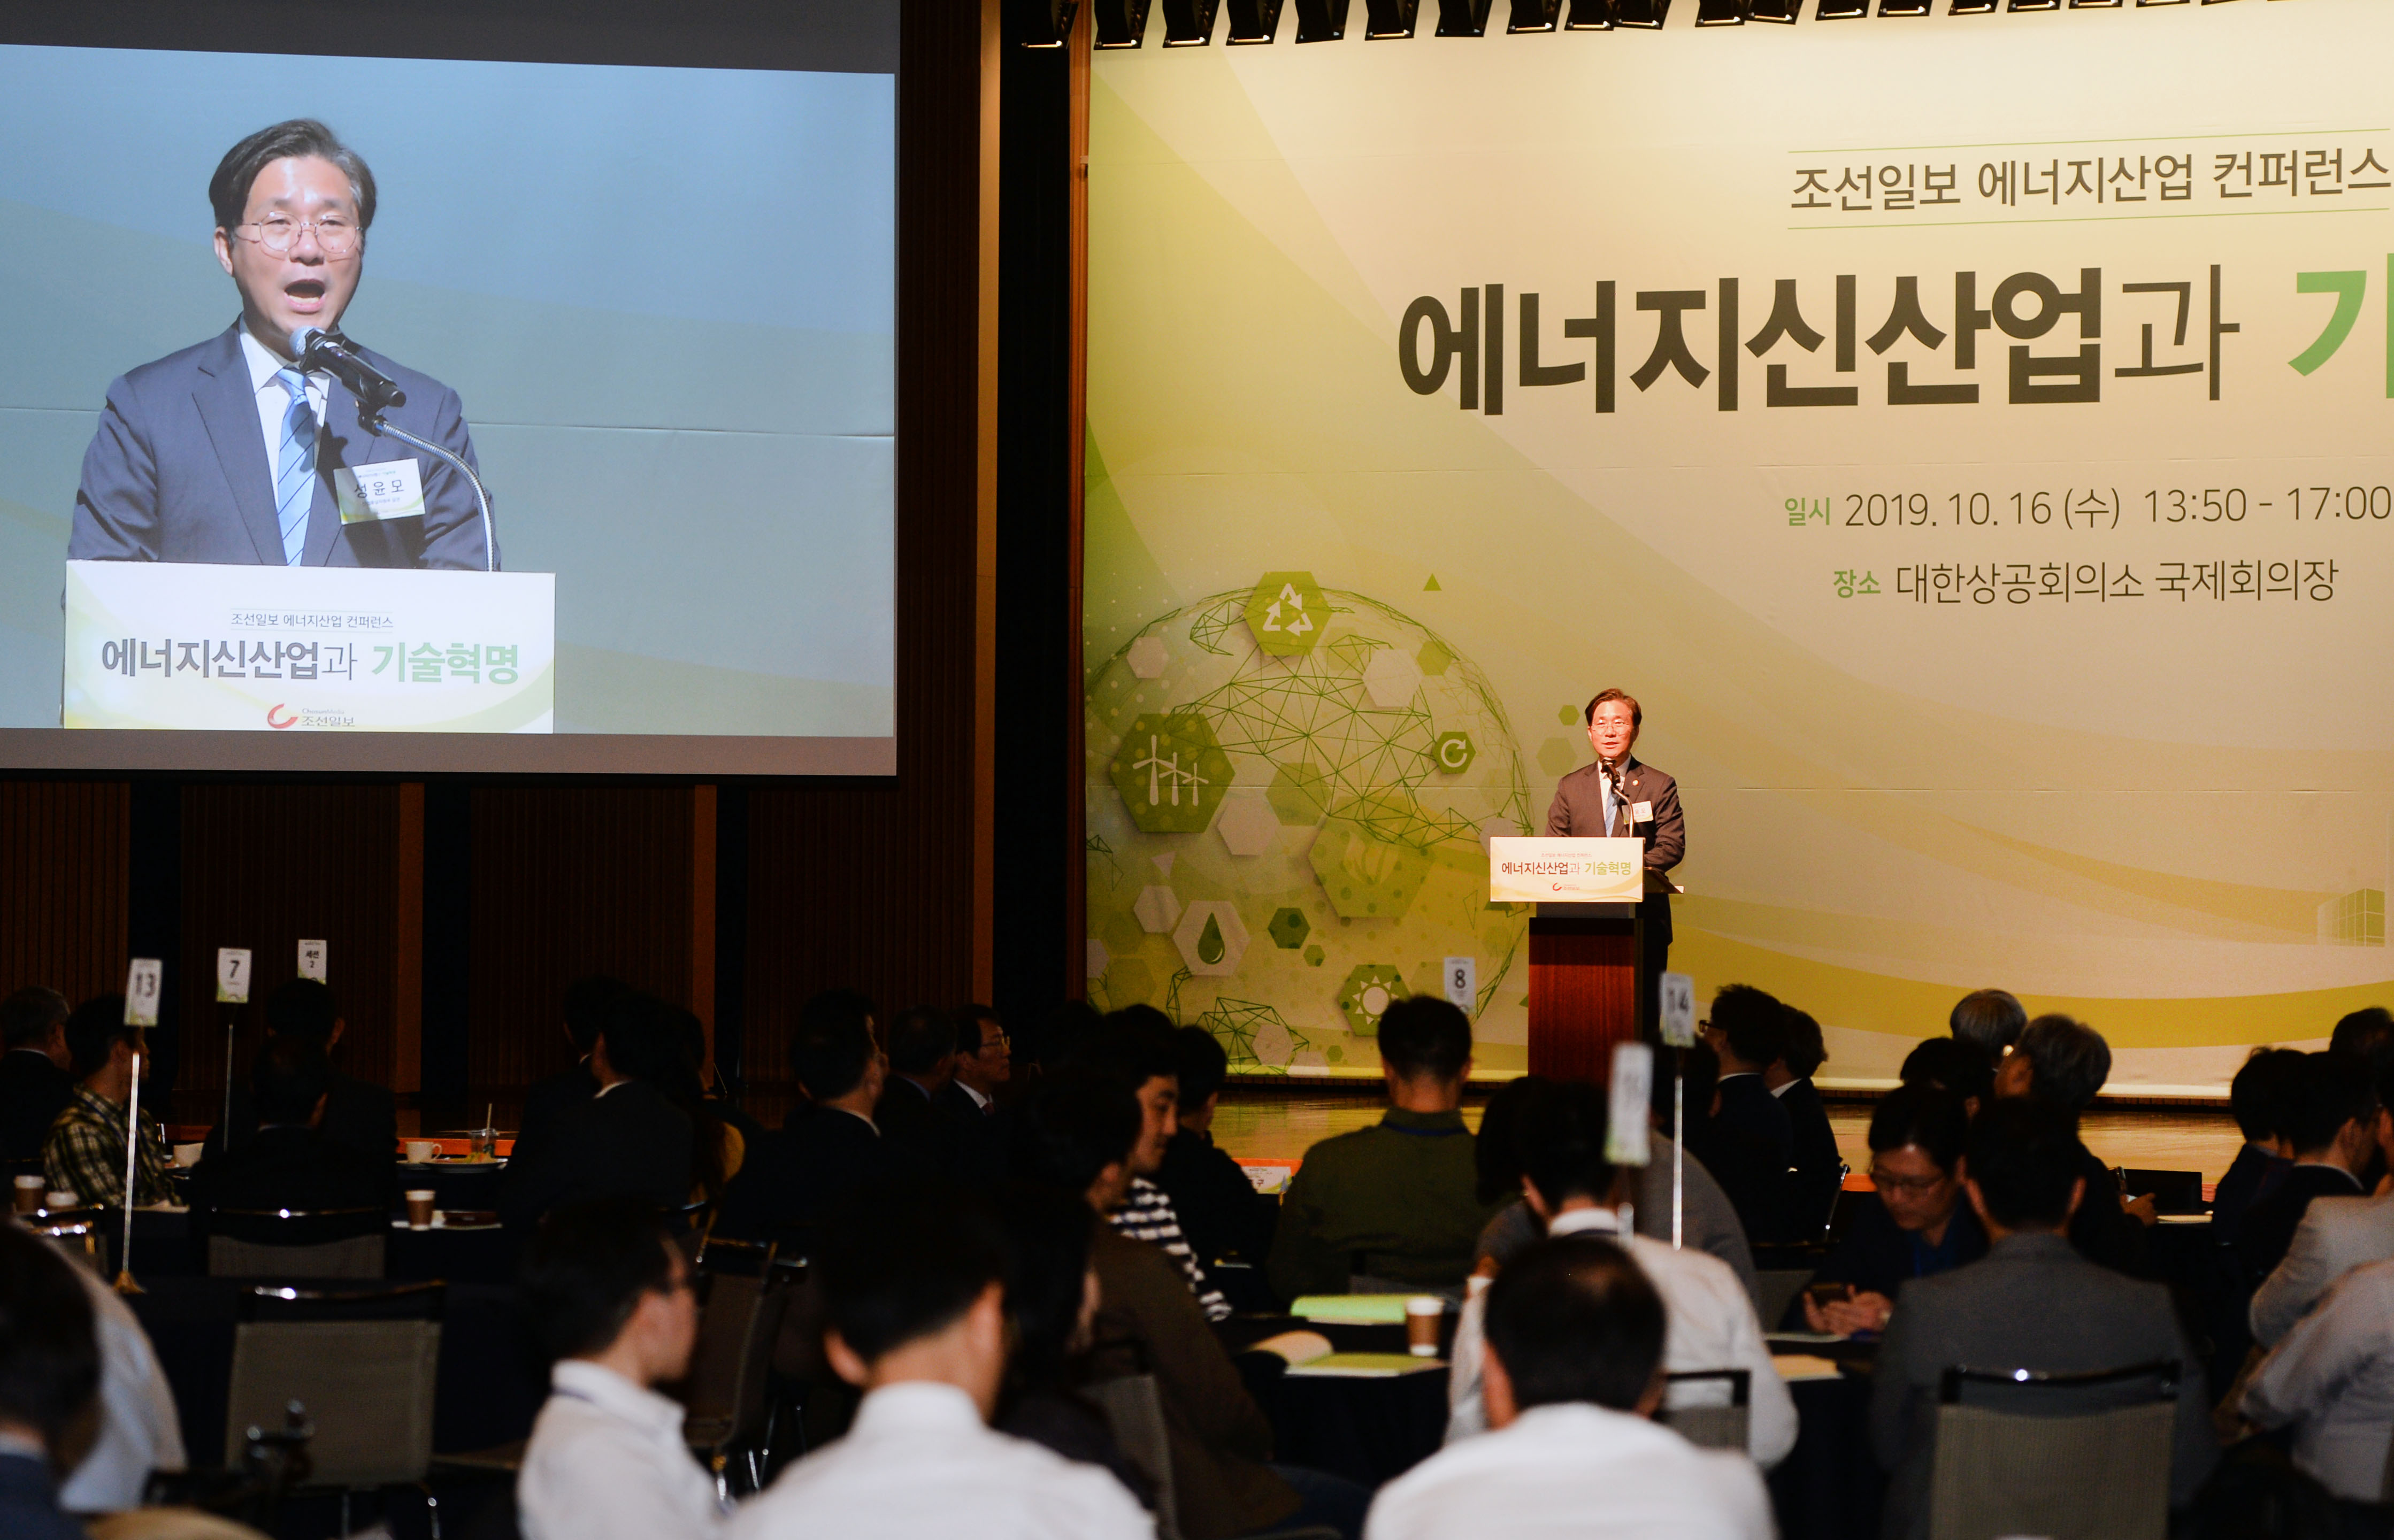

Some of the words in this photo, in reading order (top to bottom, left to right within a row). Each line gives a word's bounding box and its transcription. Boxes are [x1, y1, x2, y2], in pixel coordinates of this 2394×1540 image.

[1791, 164, 1961, 211] 조선일보
[1978, 153, 2192, 207] 에너지산업
[2213, 148, 2391, 199] 컨퍼런스
[1398, 264, 2240, 416] 에너지신산업과
[1784, 497, 1830, 527] 일시
[1845, 493, 1937, 527] 2019.
[1948, 492, 1998, 526] 10.
[2010, 491, 2052, 525] 16
[2064, 488, 2120, 530] (수)
[2145, 488, 2247, 522] 13:50
[2288, 486, 2391, 520] 17:00
[1833, 569, 1881, 599] 장소
[1897, 561, 2144, 605] 대한상공회의소
[2155, 559, 2339, 602] 국제회의장
[231, 613, 279, 627] 조선일보
[283, 614, 342, 628] 에너지산업
[347, 615, 394, 629] 컨퍼런스
[102, 637, 357, 681] 에너지신산업과
[372, 642, 519, 686] 기술혁명
[301, 715, 356, 727] 조선일보
[1501, 861, 1580, 875] 에너지신산업과
[1585, 861, 1632, 875] 기술혁명
[229, 960, 240, 979] 7
[1455, 968, 1466, 989] 8
